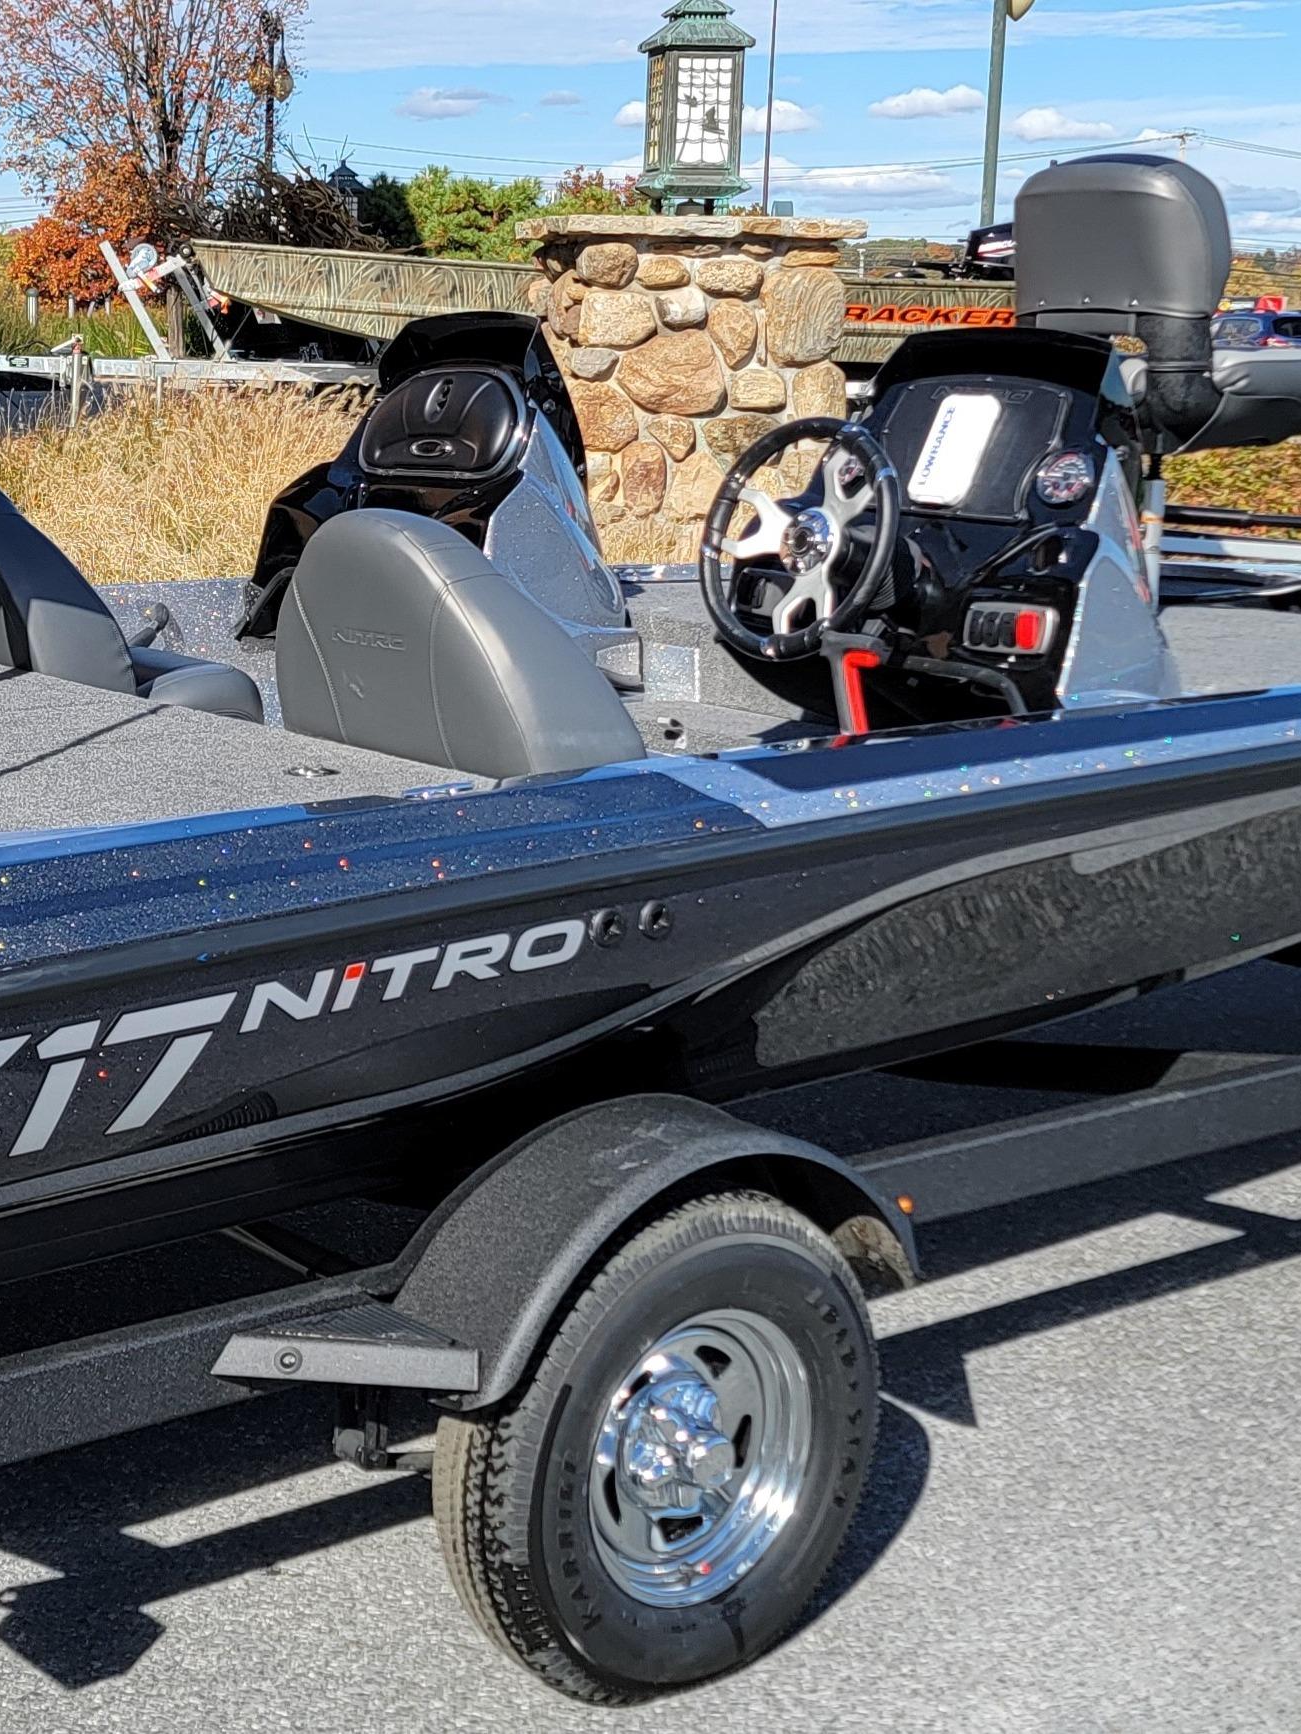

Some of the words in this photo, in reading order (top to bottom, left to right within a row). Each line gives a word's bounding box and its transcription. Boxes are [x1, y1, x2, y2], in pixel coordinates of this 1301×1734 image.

[843, 304, 1015, 327] RACKER
[918, 405, 956, 486] LOWRANCE
[332, 625, 406, 652] NITRO
[240, 918, 585, 1034] NITRO
